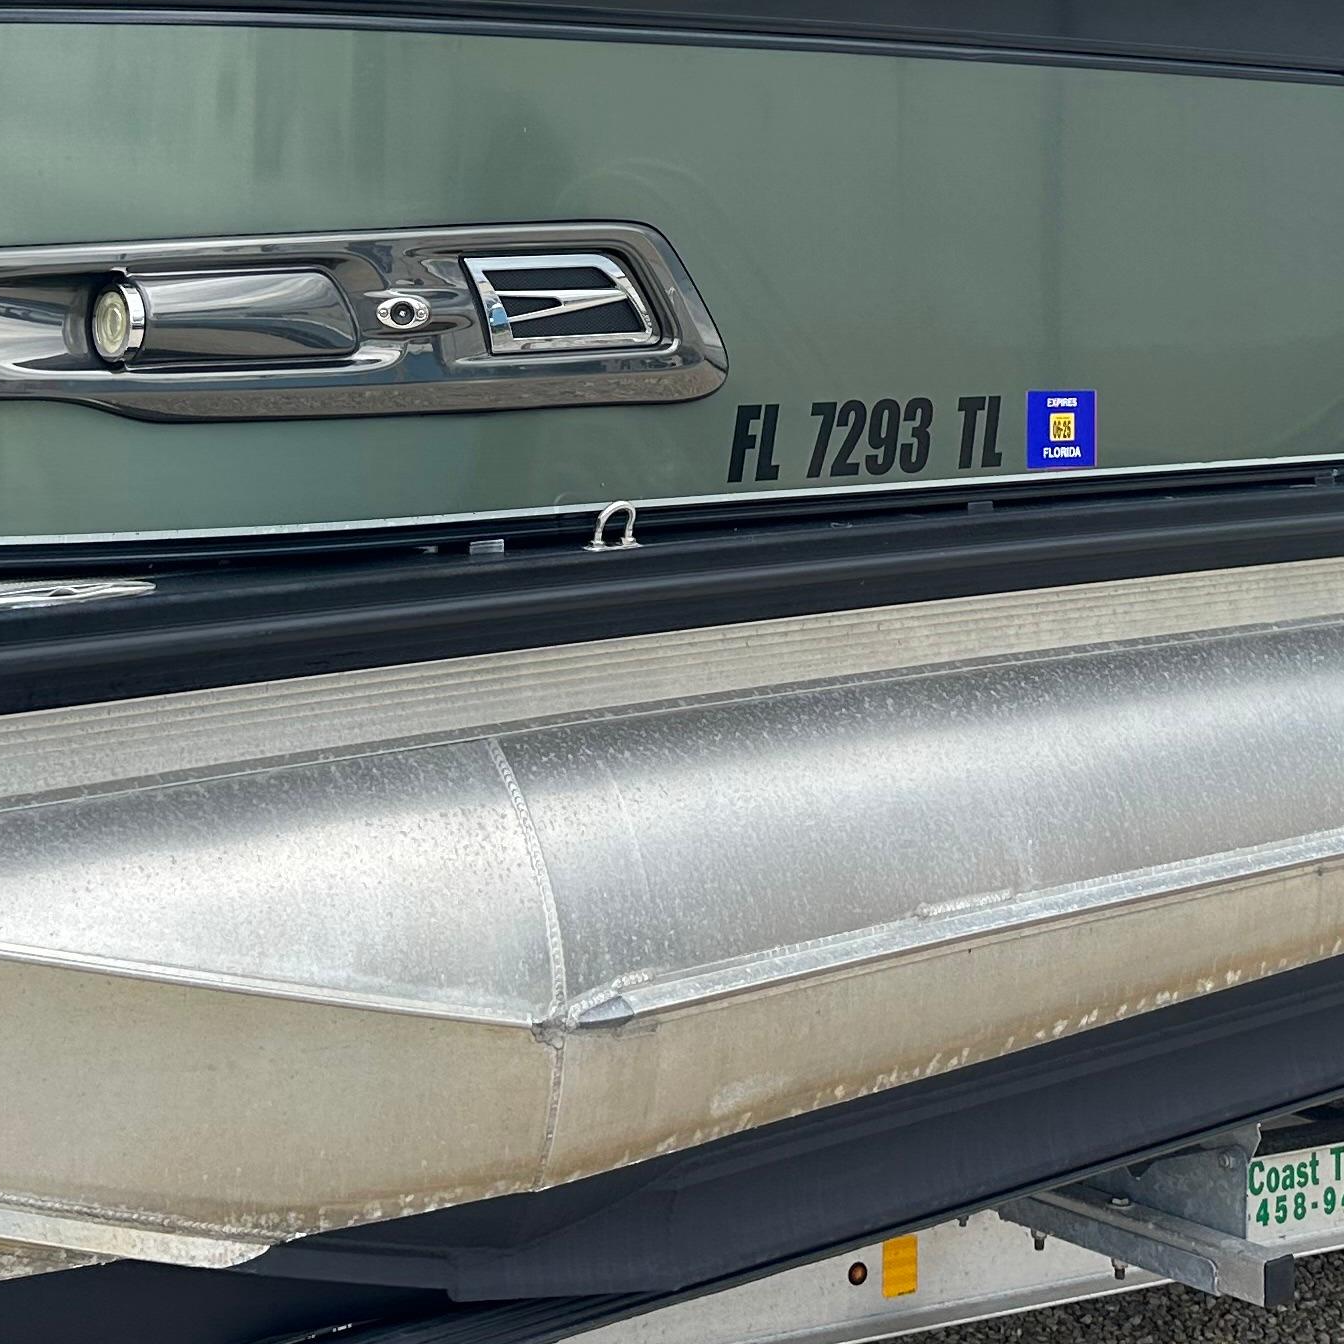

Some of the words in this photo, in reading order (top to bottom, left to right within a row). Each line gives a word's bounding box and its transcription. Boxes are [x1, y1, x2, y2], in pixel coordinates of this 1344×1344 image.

[1046, 397, 1078, 408] EXPIRES
[727, 403, 781, 483] FL
[806, 397, 934, 479] 7293
[957, 395, 1003, 470] TL
[1042, 445, 1082, 459] FLORIDA
[1248, 1152, 1320, 1196] Coast
